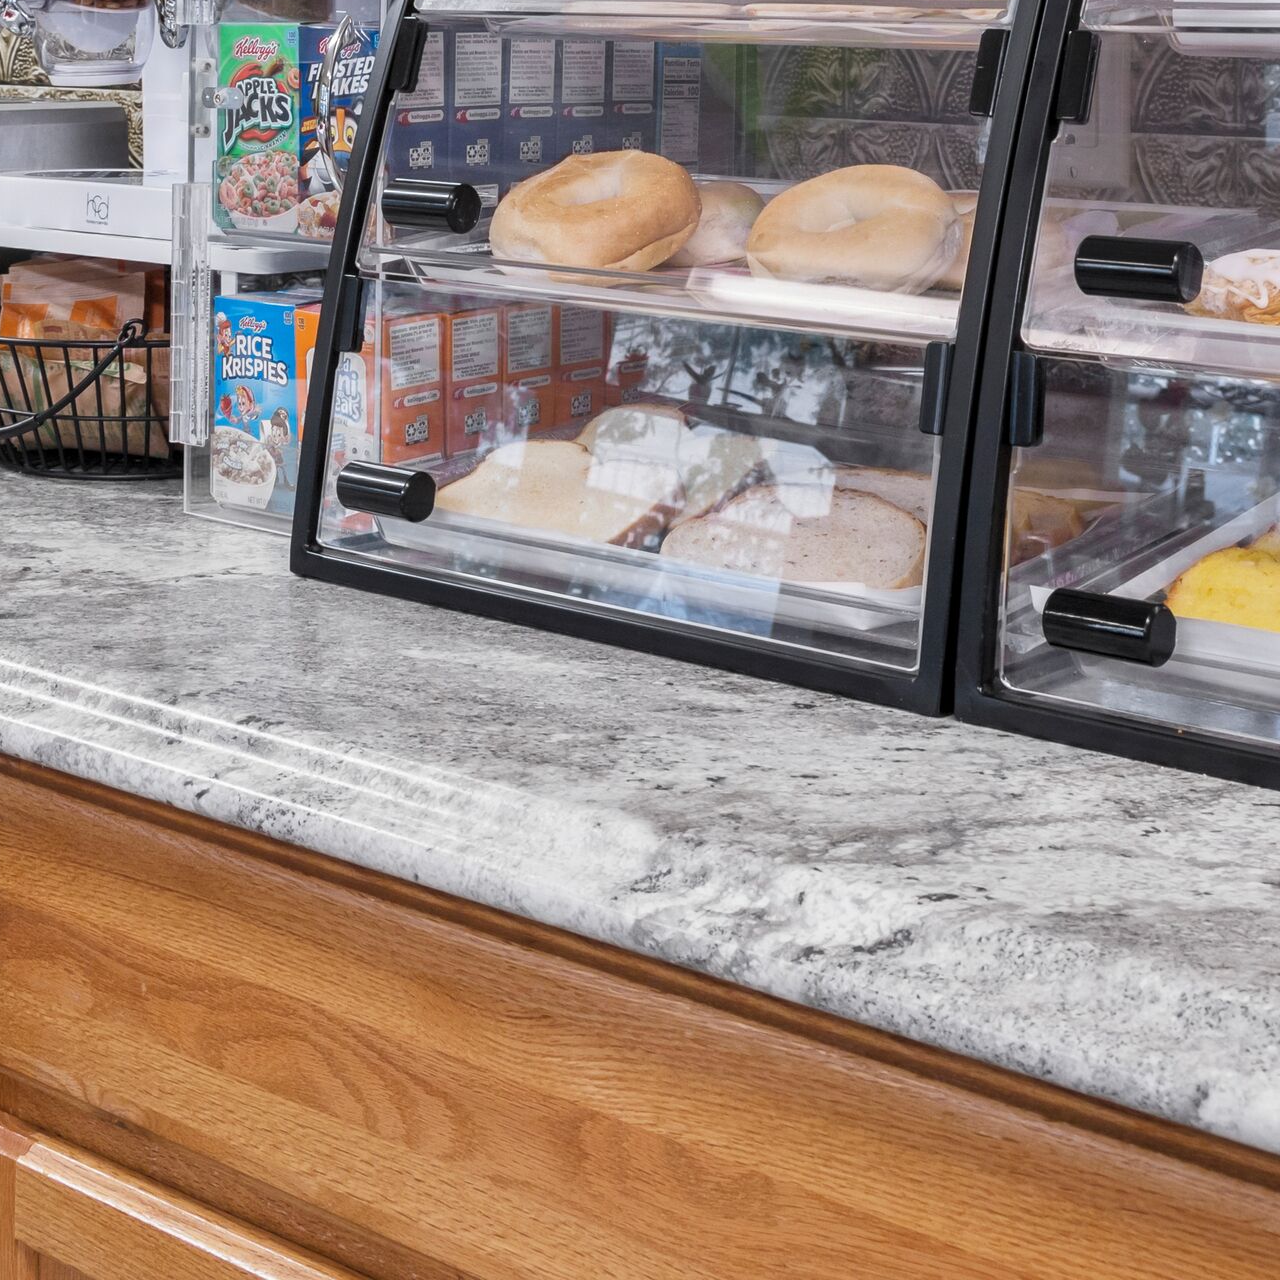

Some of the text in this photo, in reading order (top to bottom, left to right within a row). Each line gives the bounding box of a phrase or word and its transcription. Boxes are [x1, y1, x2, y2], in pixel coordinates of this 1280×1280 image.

[235, 36, 278, 61] Kellogg's
[319, 36, 362, 59] Kgg's
[308, 56, 376, 82] FOSTED
[237, 77, 276, 96] APPLE
[311, 74, 370, 100] AKES
[223, 93, 292, 153] JACKS
[239, 316, 268, 333] Kellogg's
[236, 334, 273, 360] RICE
[222, 356, 288, 386] KRISPIES
